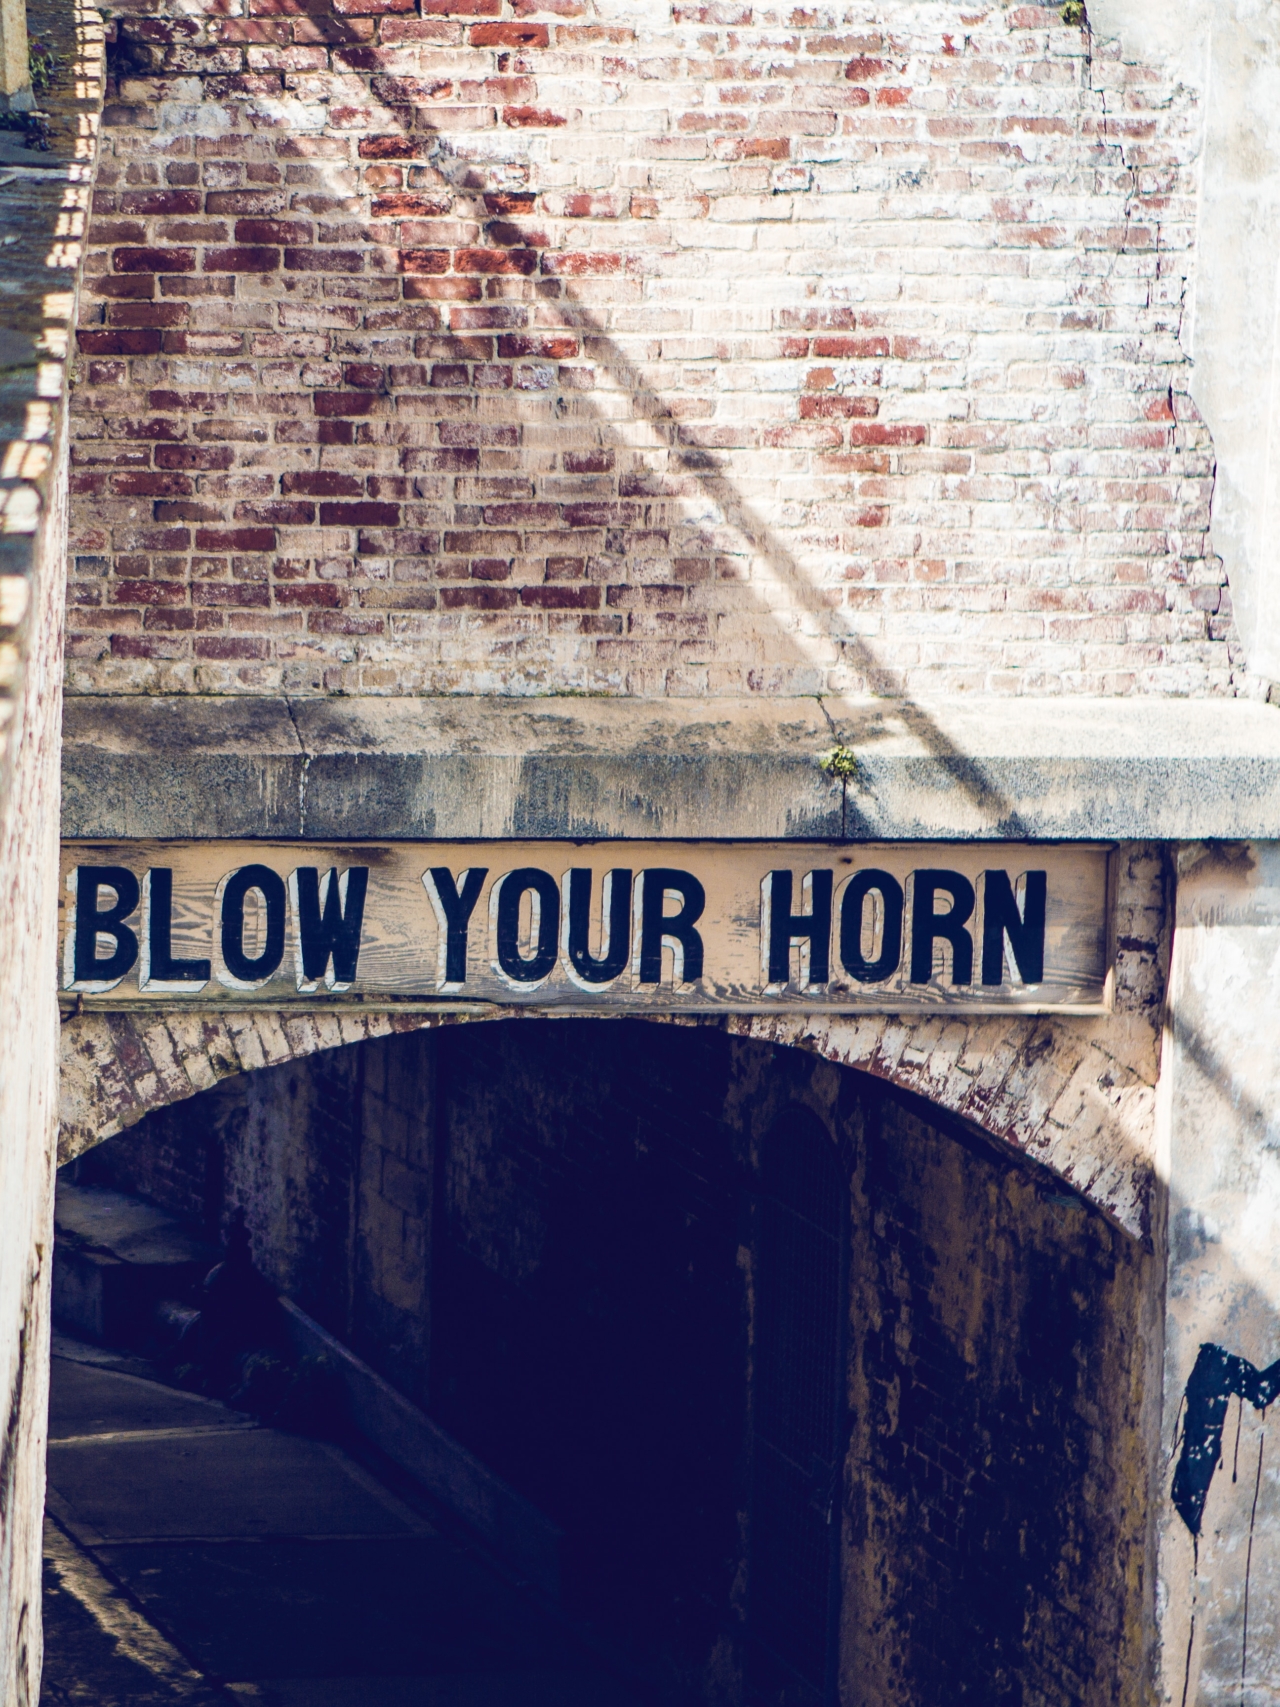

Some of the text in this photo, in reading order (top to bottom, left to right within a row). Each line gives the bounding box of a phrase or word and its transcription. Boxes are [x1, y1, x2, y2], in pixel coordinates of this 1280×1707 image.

[64, 863, 1047, 995] BLOW YOUR HORN
